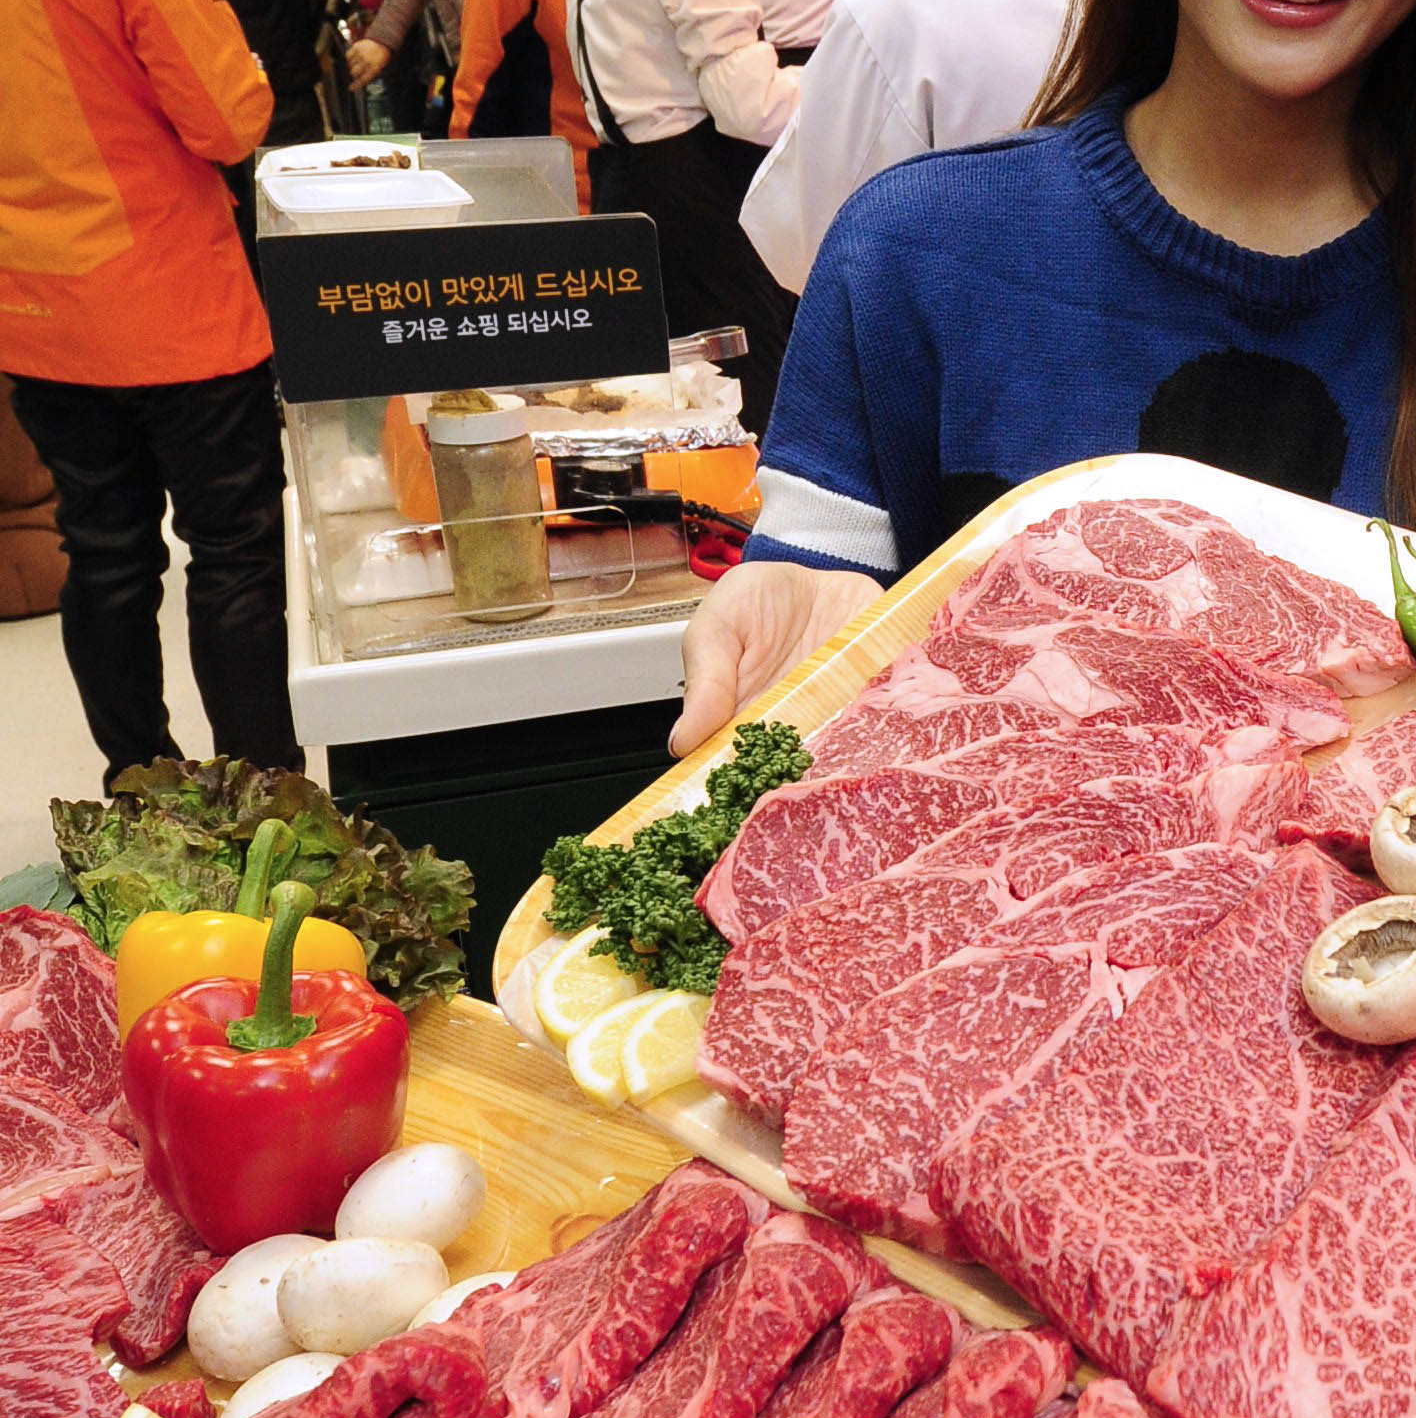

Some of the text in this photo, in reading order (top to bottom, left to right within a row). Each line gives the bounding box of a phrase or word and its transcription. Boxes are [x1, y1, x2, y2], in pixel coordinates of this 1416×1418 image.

[317, 266, 643, 315] 부담없이 맛있게 드십시오
[381, 309, 594, 345] 즐거운 쇼핑 되십시오
